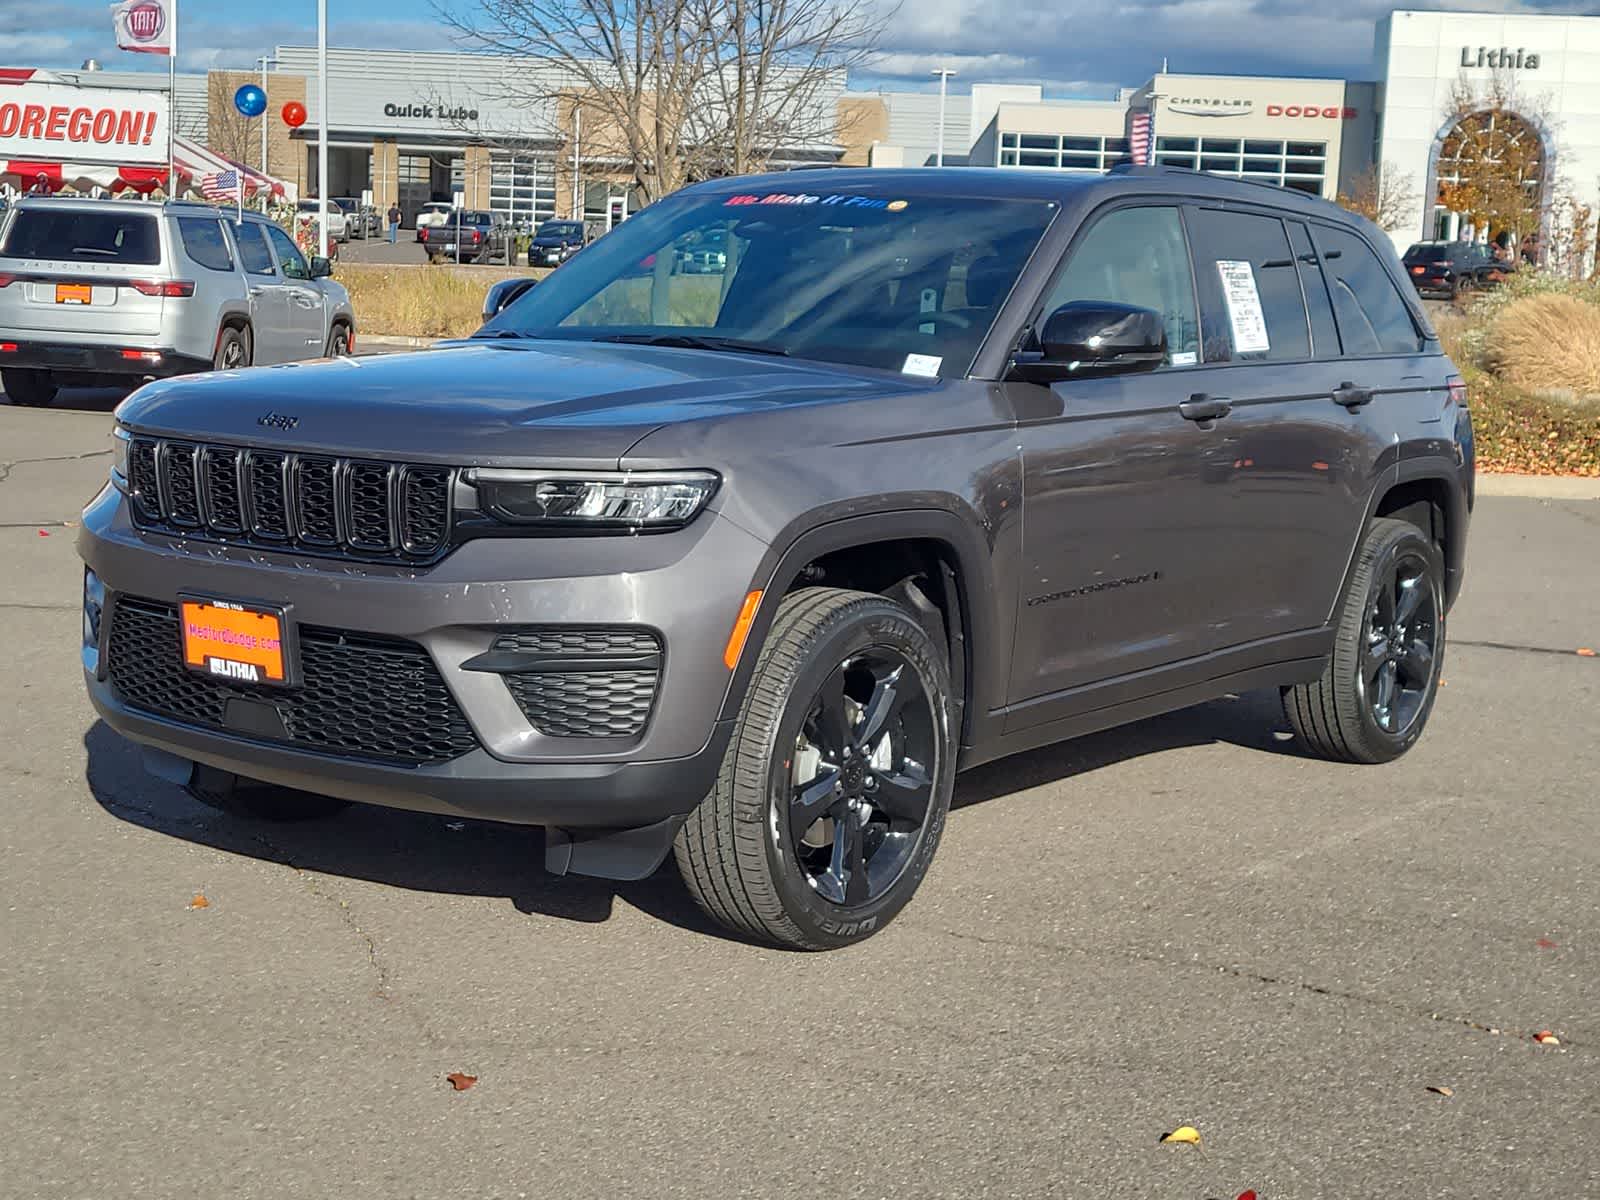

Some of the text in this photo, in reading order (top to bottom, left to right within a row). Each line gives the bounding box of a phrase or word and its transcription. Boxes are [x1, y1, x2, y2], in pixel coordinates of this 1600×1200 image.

[1460, 46, 1540, 69] Lithia
[384, 103, 479, 120] Quick Lube
[1170, 97, 1252, 107] CHRYSLER
[1266, 104, 1358, 119] DODGE
[0, 102, 157, 146] OREGON!
[760, 194, 820, 204] Make
[257, 410, 299, 431] Jeep
[220, 660, 258, 681] LITHIA
